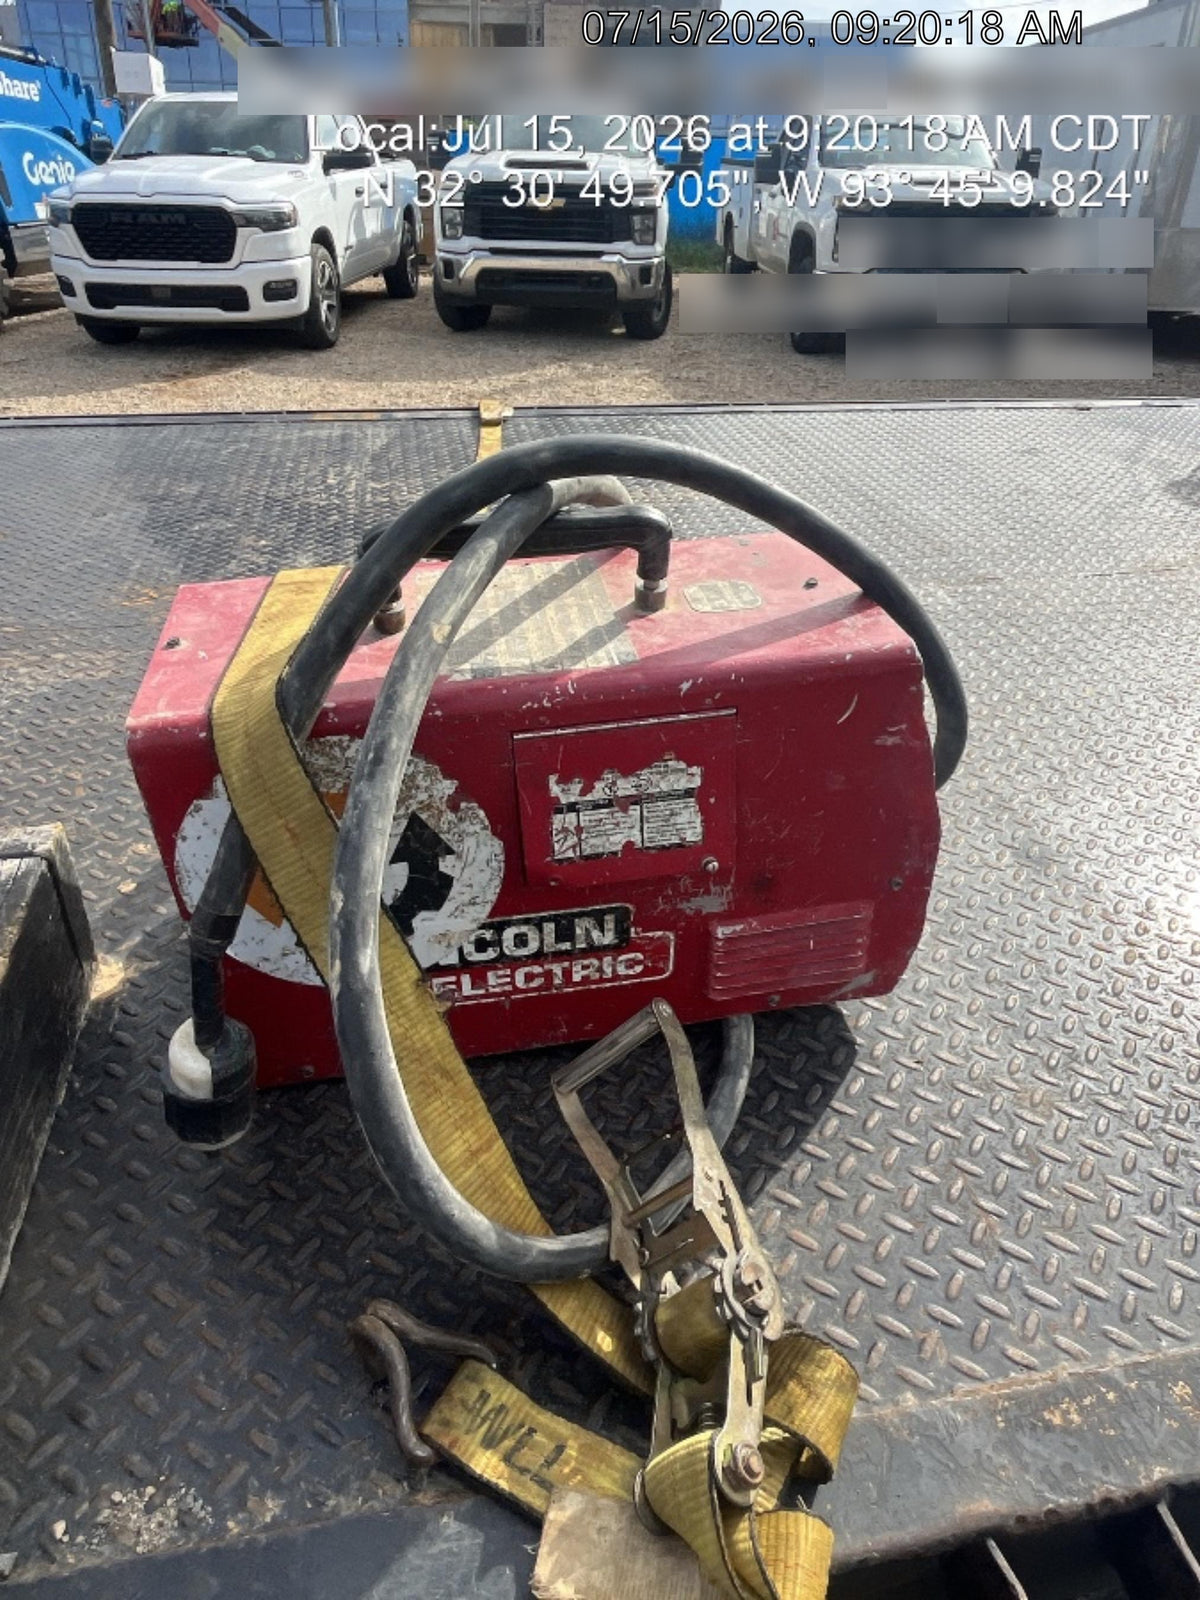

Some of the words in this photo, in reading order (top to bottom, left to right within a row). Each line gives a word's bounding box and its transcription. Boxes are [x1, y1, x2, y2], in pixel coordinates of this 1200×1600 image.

[109, 211, 188, 225] RAM
[461, 913, 617, 963] COLN
[430, 952, 645, 997] ELECTRIC
